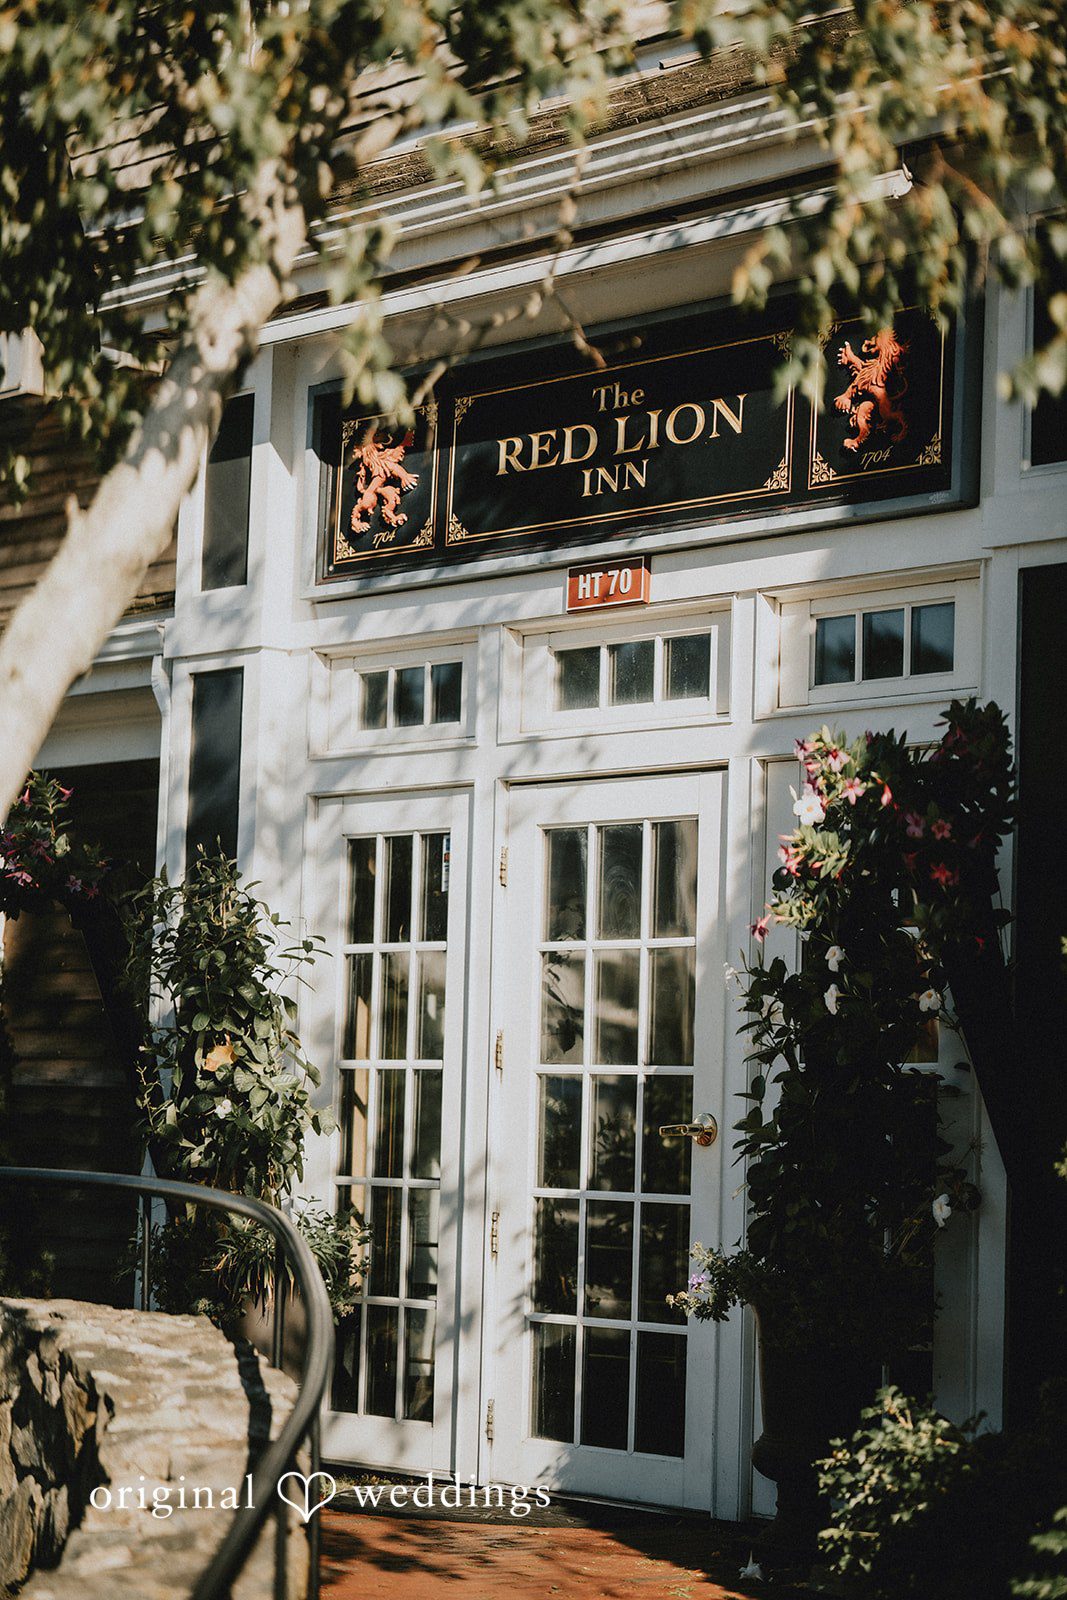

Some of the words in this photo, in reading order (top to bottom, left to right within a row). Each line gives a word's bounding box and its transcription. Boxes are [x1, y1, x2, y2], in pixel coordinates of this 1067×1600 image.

[592, 381, 645, 412] The
[496, 423, 599, 476] RED
[613, 393, 748, 456] LION
[860, 445, 894, 470] 1704
[581, 459, 650, 498] INN
[372, 528, 398, 549] 1704
[578, 571, 603, 600] HT
[607, 567, 632, 595] 70
